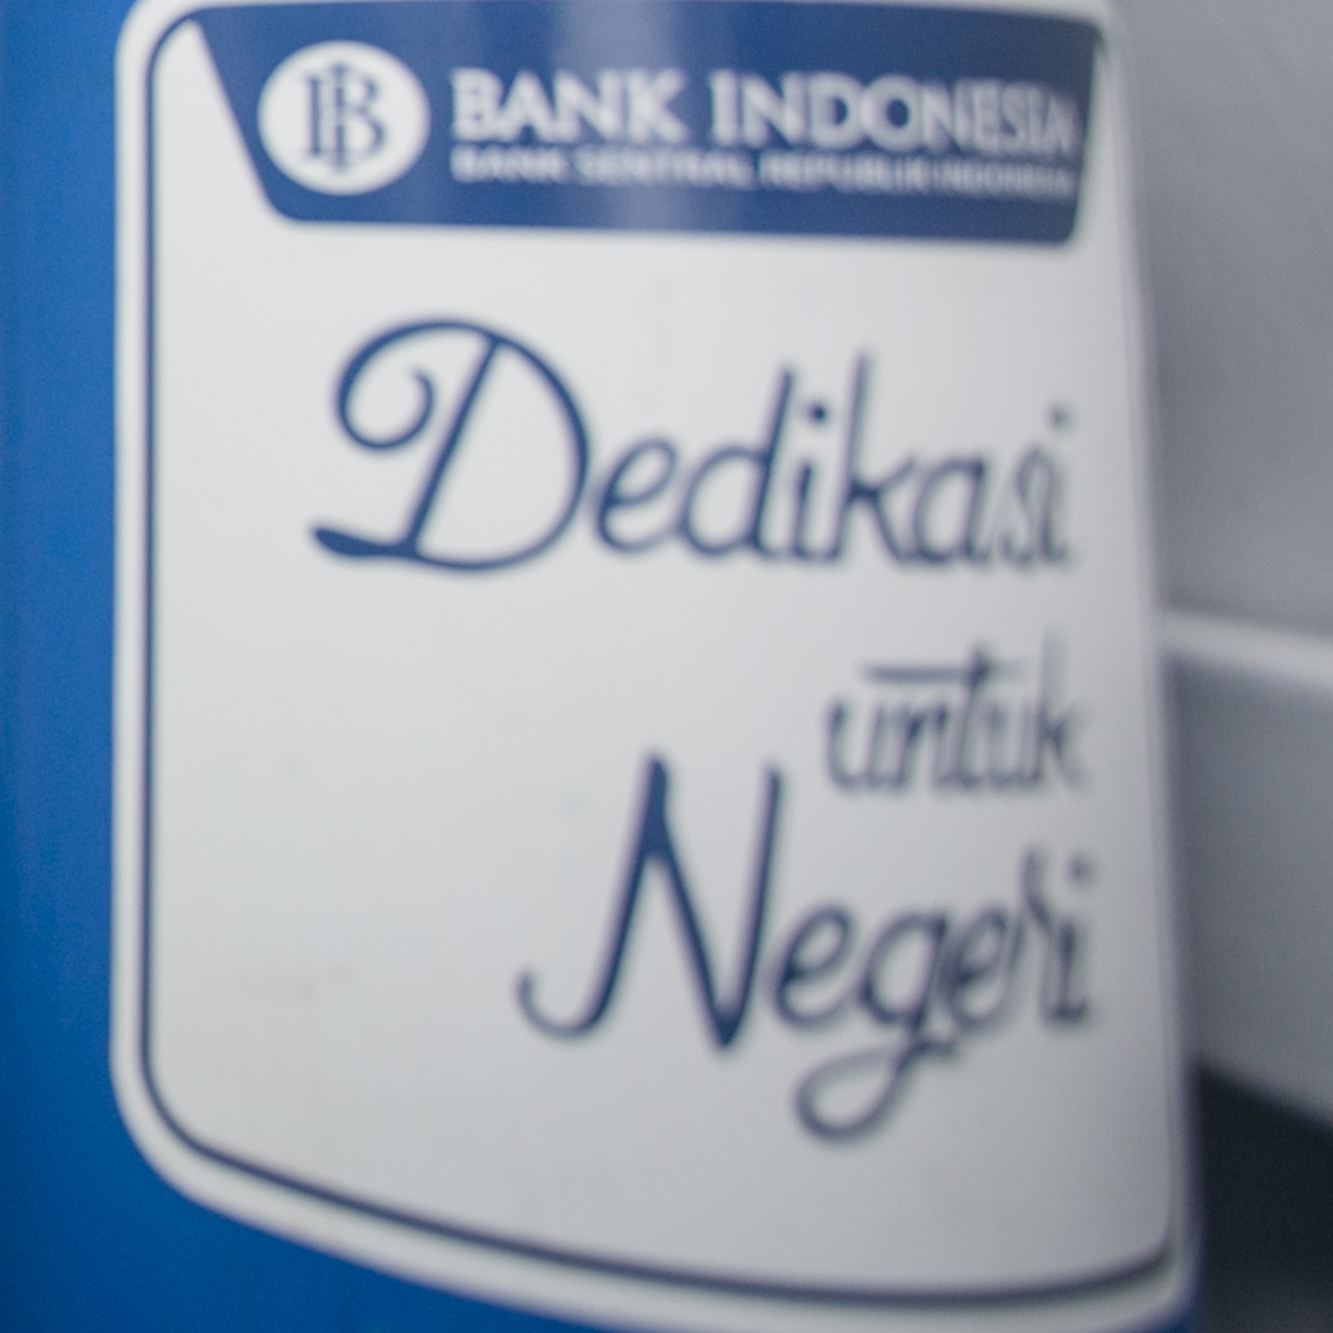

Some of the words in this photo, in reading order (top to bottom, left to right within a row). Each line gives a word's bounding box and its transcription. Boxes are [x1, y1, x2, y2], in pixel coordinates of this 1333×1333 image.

[450, 67, 689, 144] BANK
[710, 68, 1080, 158] INDONESIA
[309, 317, 1075, 573] Dedikasi
[823, 632, 1085, 794] untuk
[514, 751, 1095, 1146] Negeri
